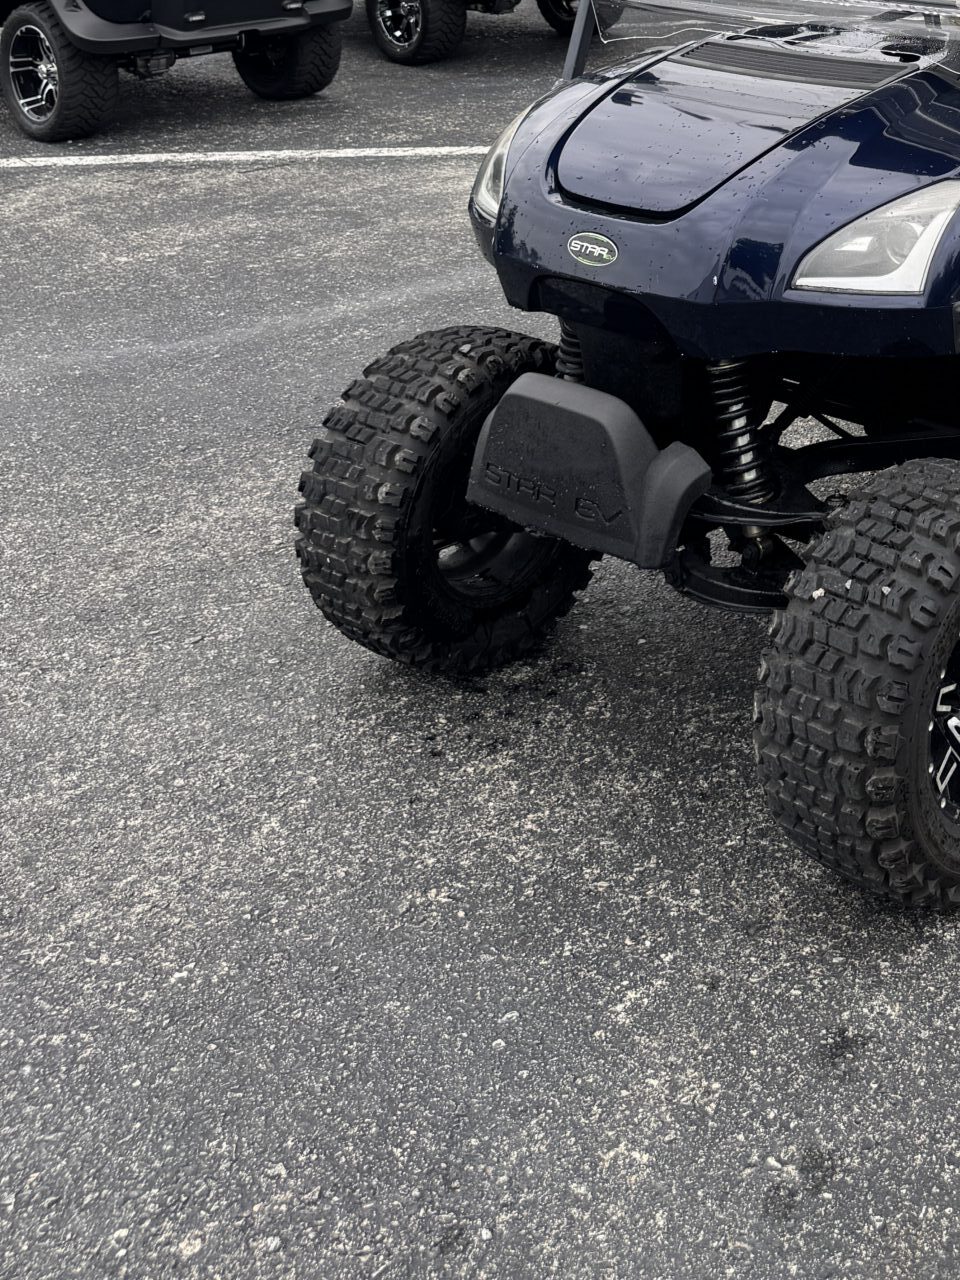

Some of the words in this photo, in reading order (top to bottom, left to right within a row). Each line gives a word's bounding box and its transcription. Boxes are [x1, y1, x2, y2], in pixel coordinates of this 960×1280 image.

[570, 240, 609, 259] STAR
[485, 462, 557, 508] STAR
[576, 497, 622, 525] EV
